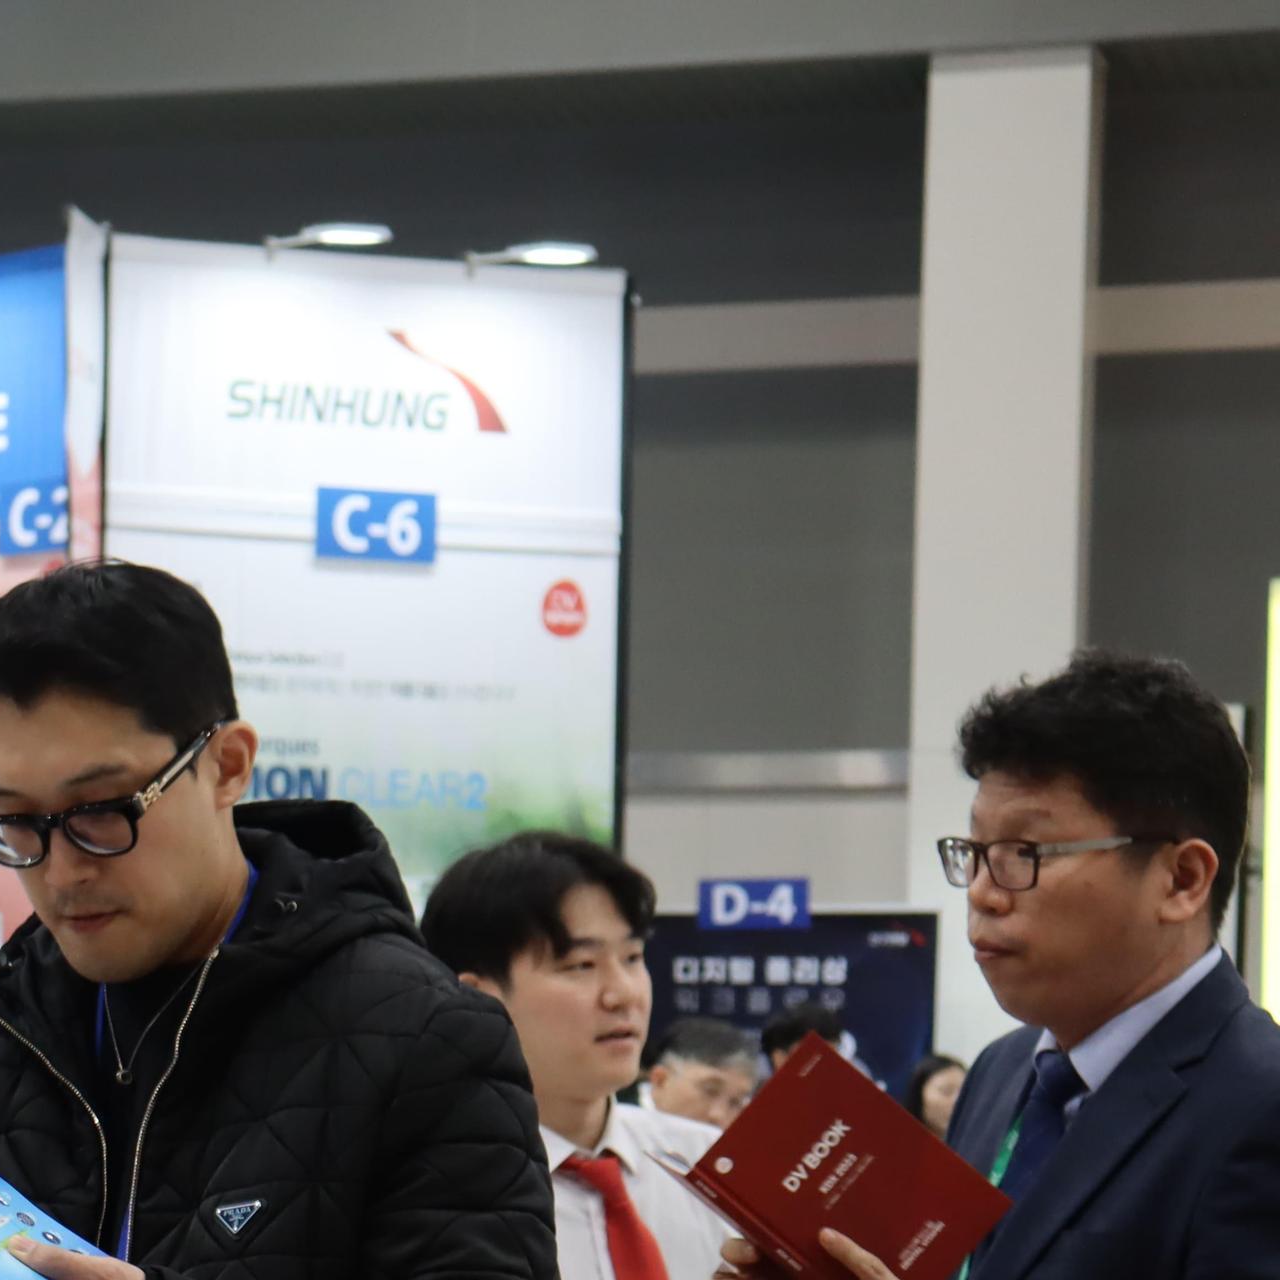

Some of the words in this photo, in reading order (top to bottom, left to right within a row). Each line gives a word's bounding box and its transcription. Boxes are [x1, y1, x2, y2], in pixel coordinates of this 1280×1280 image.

[225, 379, 451, 432] SHINHUNG
[331, 495, 421, 556] C-6
[710, 884, 797, 926] D-4
[782, 1163, 809, 1193] DV
[801, 1119, 851, 1170] BOOK
[223, 1206, 251, 1217] PRADA
